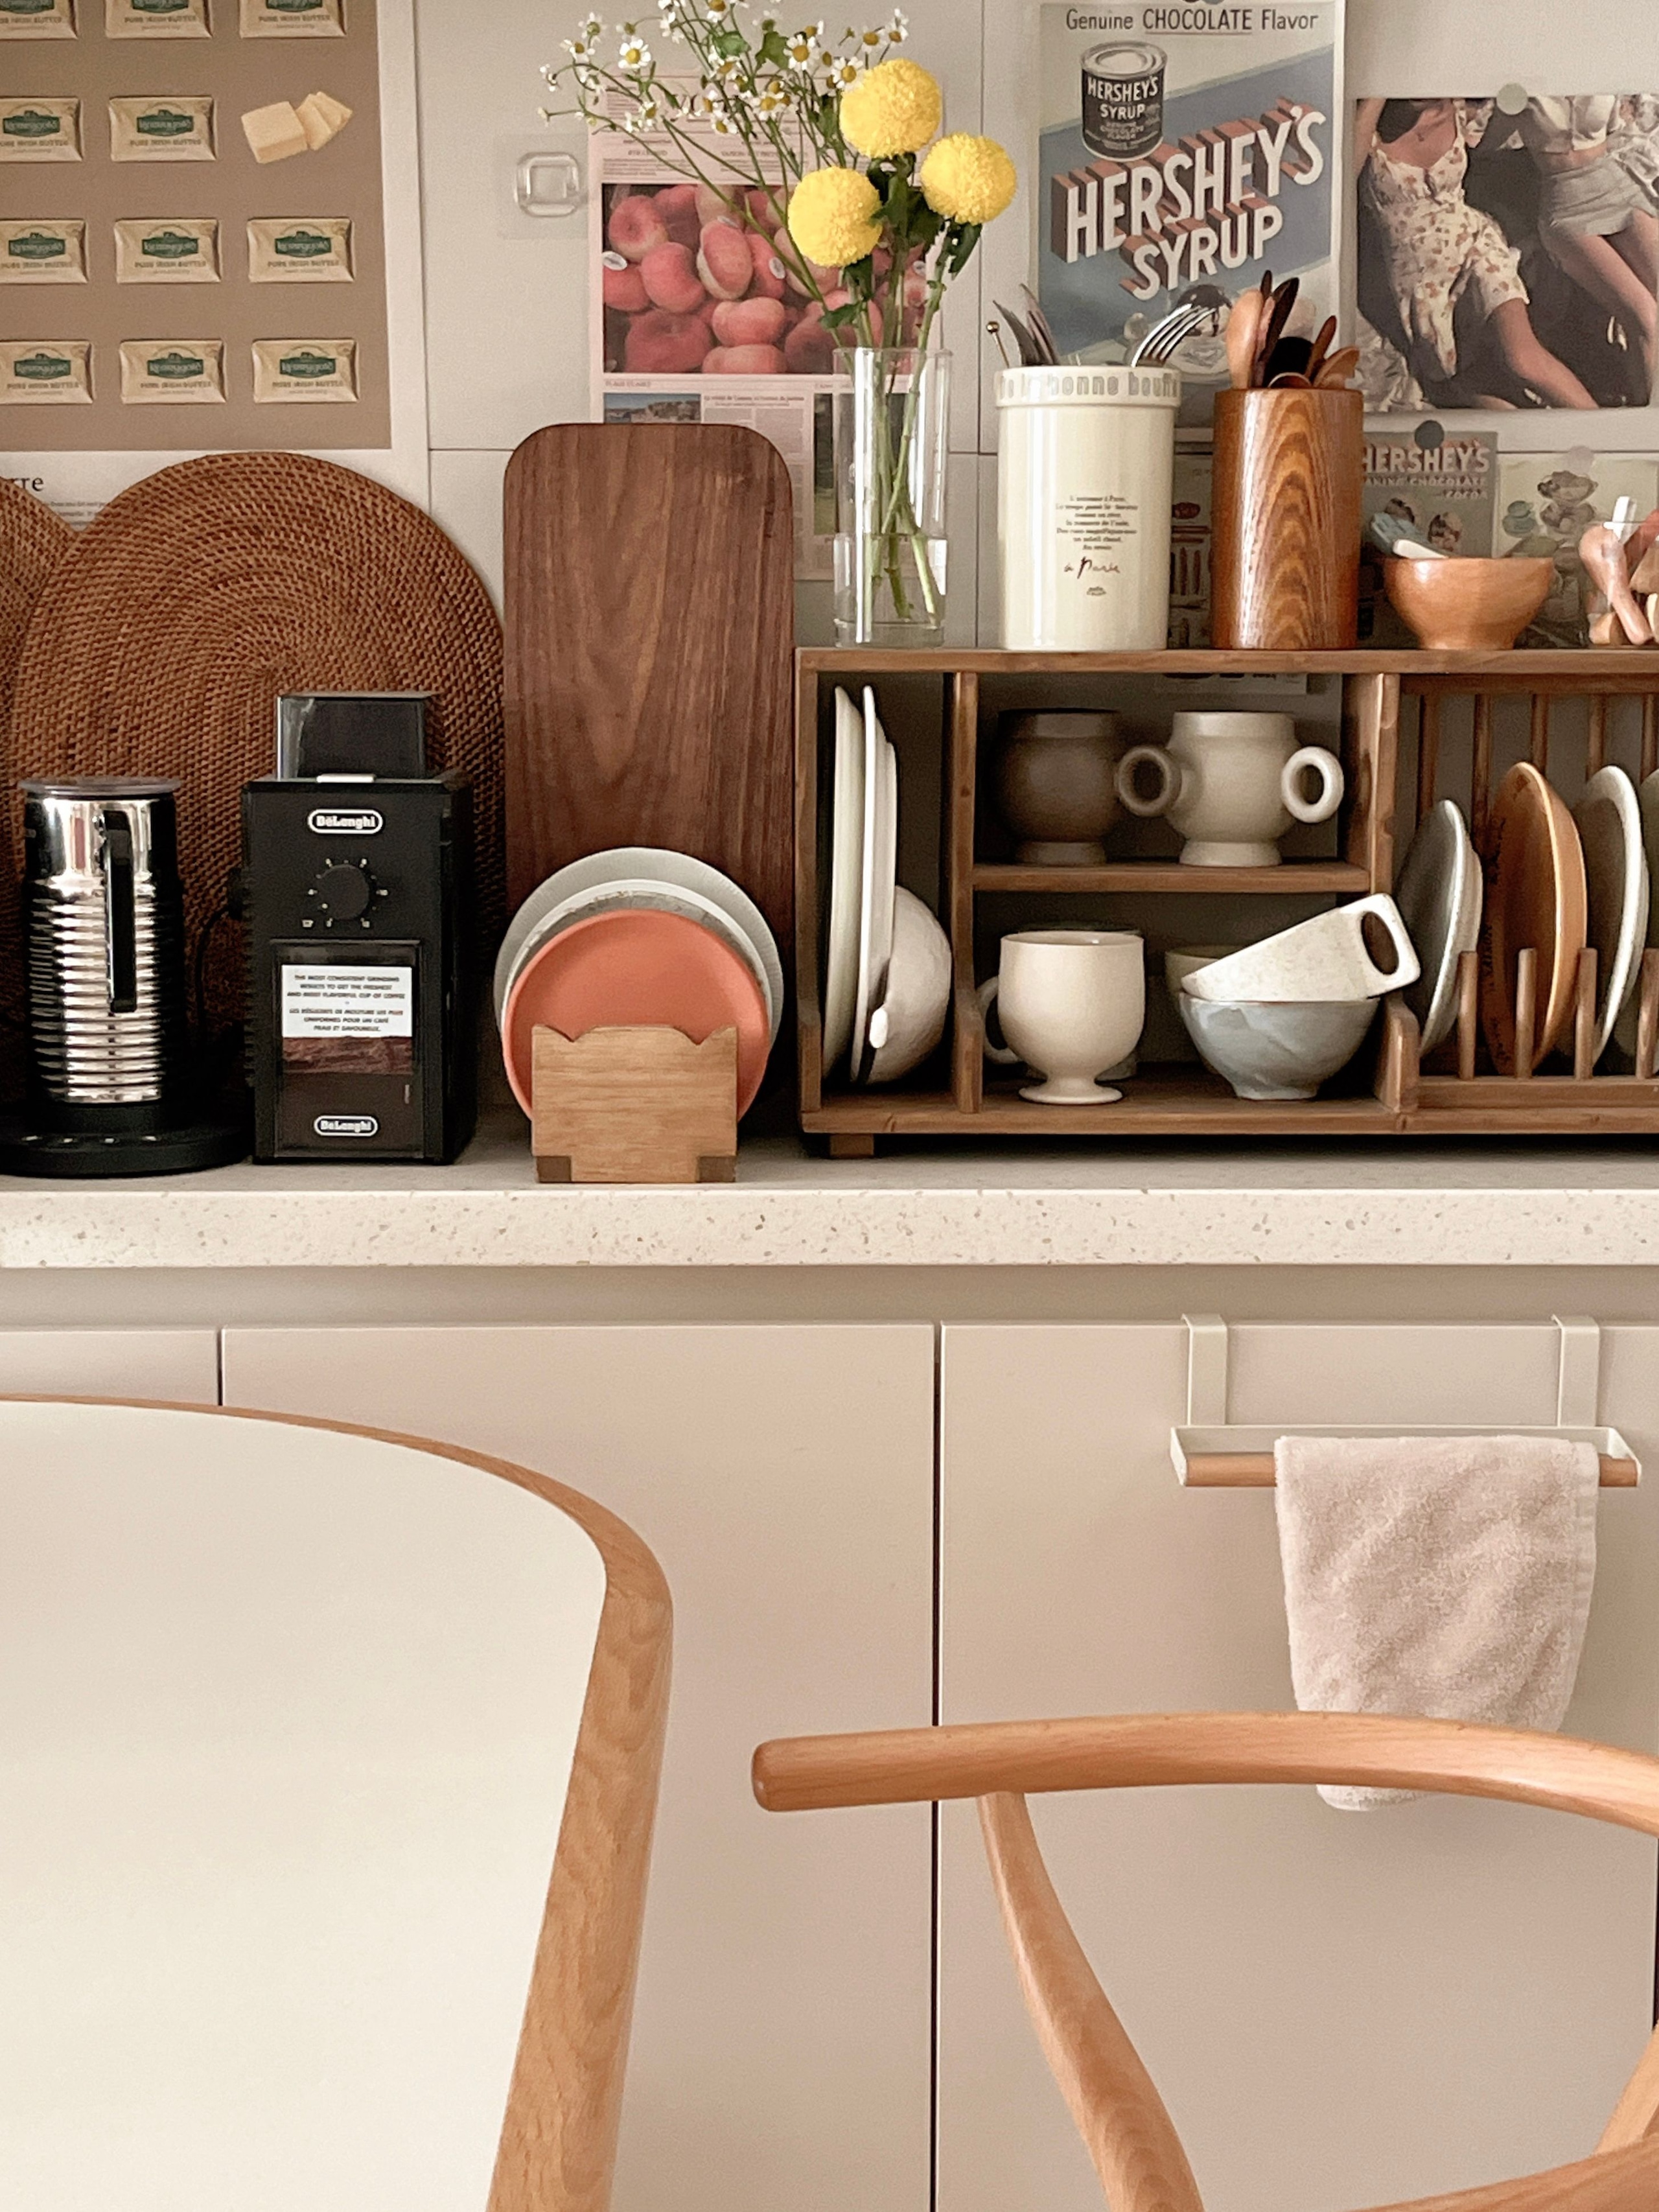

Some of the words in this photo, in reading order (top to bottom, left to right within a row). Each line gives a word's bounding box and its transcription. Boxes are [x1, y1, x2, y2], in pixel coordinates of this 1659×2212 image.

[1066, 8, 1133, 30] Genuine
[1143, 8, 1253, 30] CHOCOLATE
[1261, 8, 1319, 30] Flavor
[1087, 76, 1159, 102] HERSHEY'S
[1100, 103, 1146, 120] SYRUP
[1064, 105, 1327, 264] HERSHEY'S
[1131, 205, 1284, 301] SYRUP
